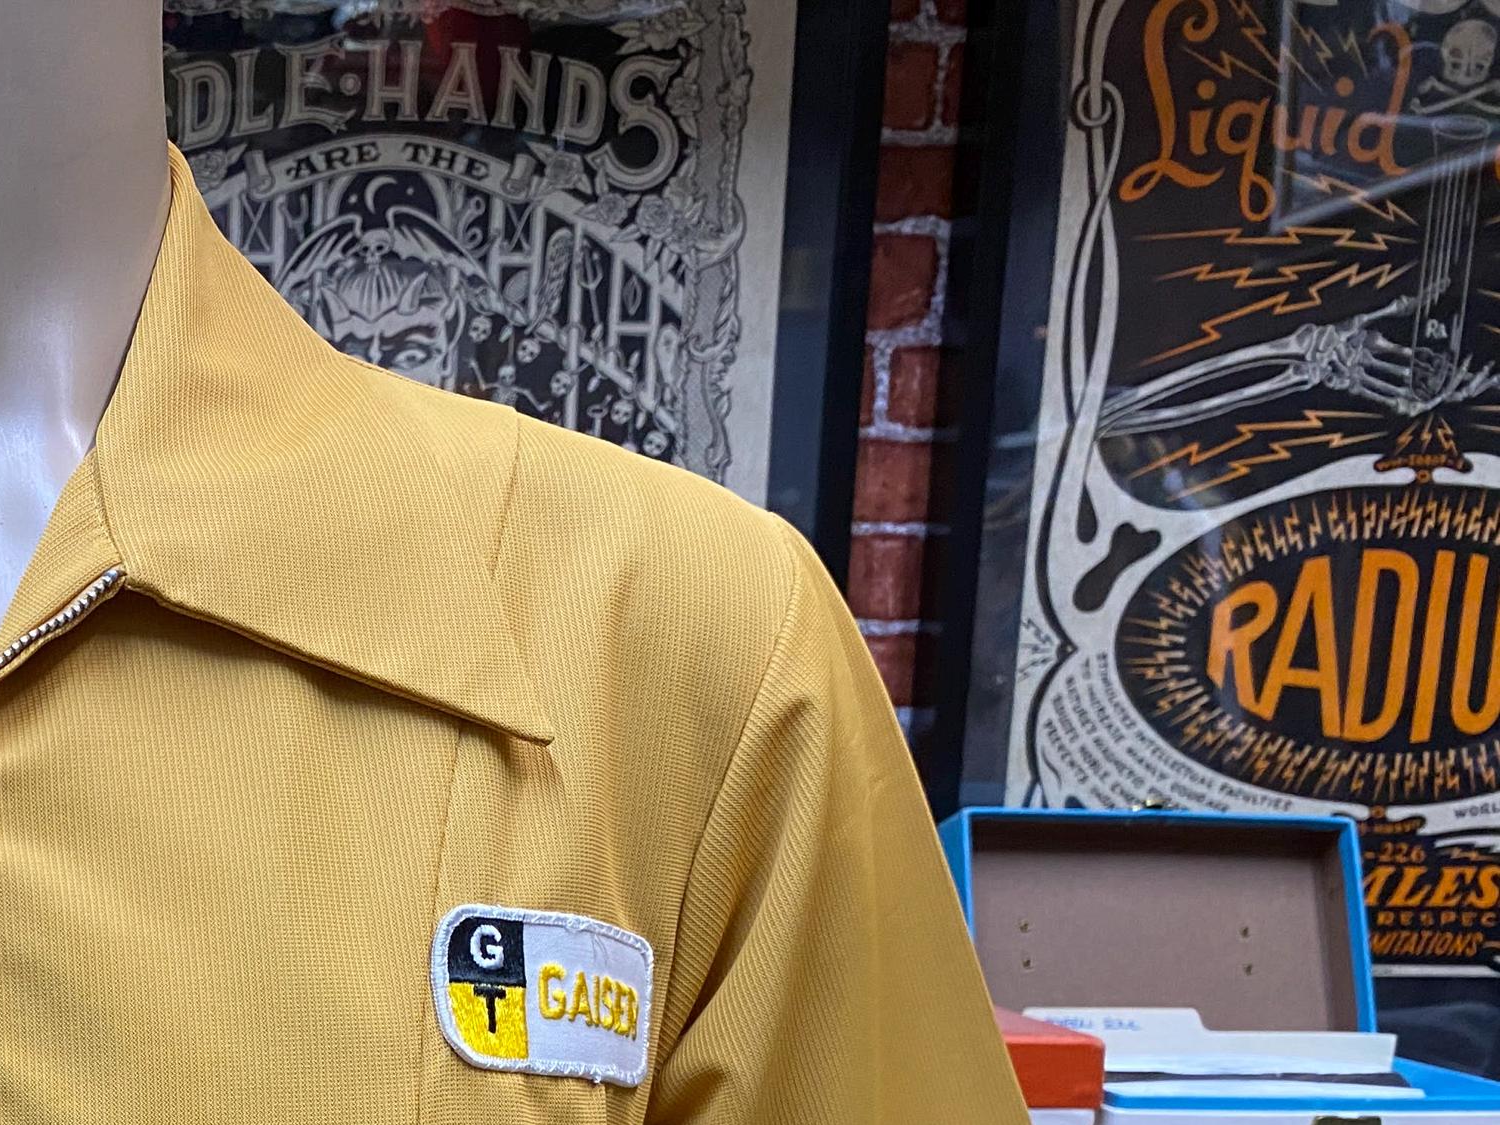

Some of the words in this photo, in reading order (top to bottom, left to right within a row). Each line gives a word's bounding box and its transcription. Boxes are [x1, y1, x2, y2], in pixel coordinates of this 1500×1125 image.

[366, 38, 690, 190] HANDS
[1119, 0, 1410, 222] Liquid
[286, 141, 383, 179] ARE
[403, 143, 490, 181] THE
[469, 924, 505, 971] G
[472, 983, 507, 1034] T
